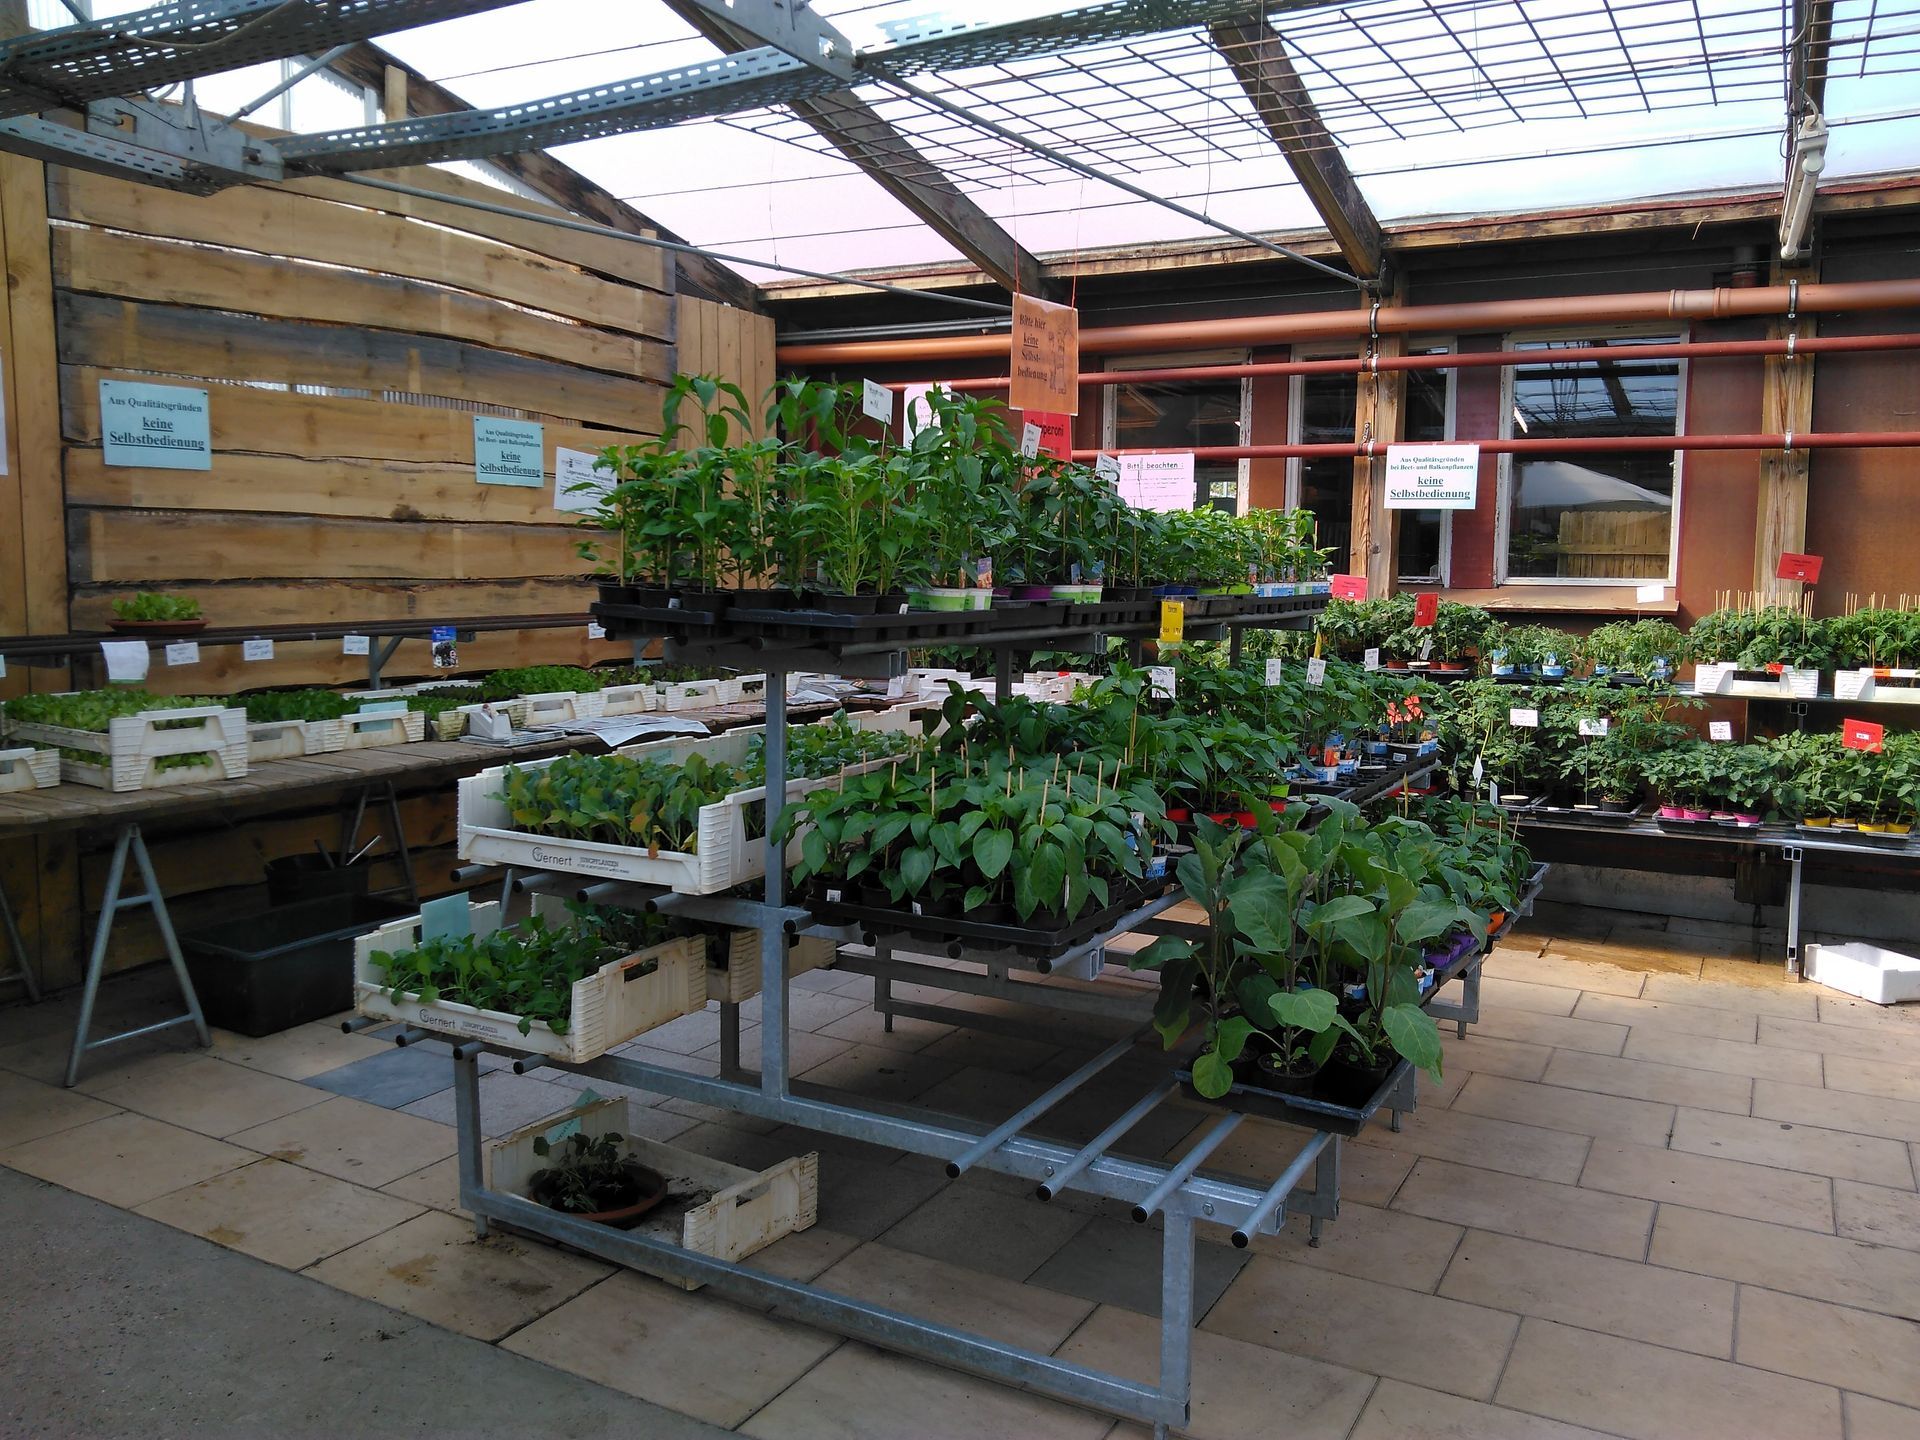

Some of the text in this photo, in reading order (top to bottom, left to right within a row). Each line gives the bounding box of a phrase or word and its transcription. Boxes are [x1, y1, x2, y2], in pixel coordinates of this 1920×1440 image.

[1019, 313, 1046, 330] Bitte hier
[1024, 333, 1039, 346] keine
[1017, 366, 1048, 381] bedienung
[109, 396, 202, 413] Aus Qualitätsgründen
[143, 416, 173, 431] keine
[1030, 418, 1064, 438] Pperoni
[109, 431, 205, 452] Selbstbedienung
[501, 450, 522, 462] keine
[1413, 456, 1465, 464] Qualitätsgründen
[480, 462, 542, 478] Selbstbedienung
[1417, 476, 1444, 487] keine
[1390, 489, 1471, 500] Selbstbedienung
[532, 846, 573, 866] Gernert
[419, 1008, 456, 1029] Gernert
